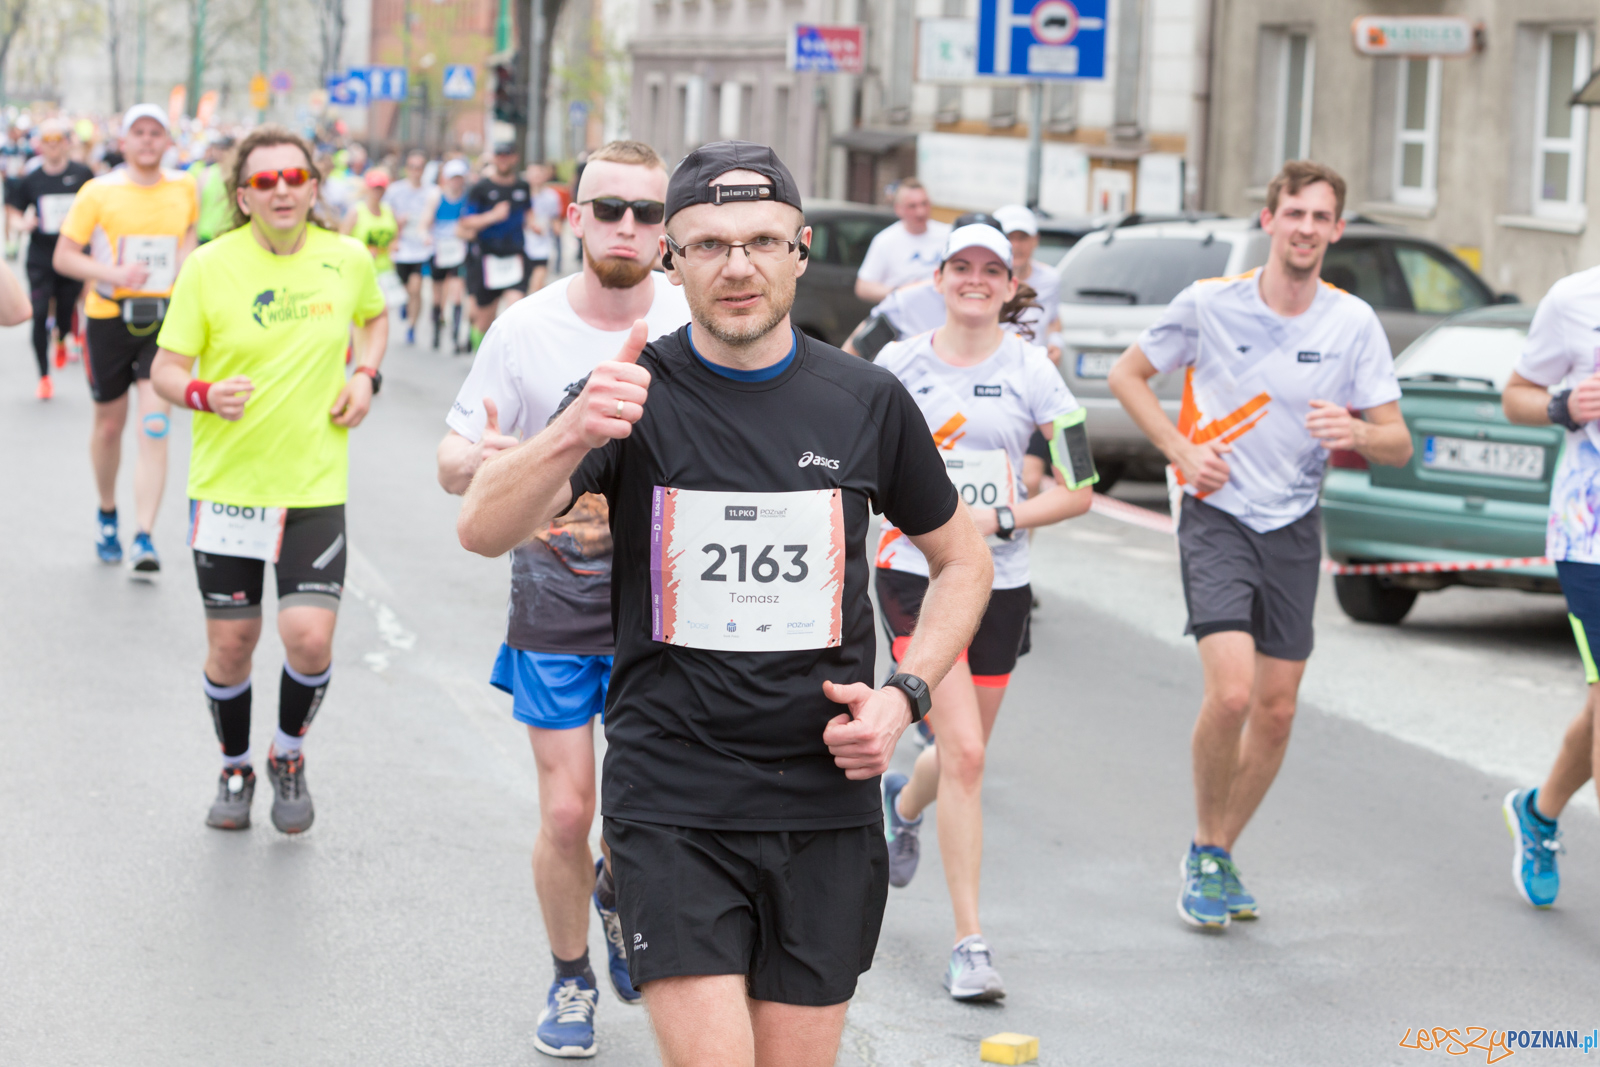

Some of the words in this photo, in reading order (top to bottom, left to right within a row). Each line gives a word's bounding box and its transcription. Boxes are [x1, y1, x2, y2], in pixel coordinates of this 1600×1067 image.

[721, 189, 757, 197] alenji
[267, 304, 308, 322] WORLD
[729, 509, 738, 517] 11.
[738, 509, 755, 517] PKO
[700, 543, 809, 584] 2163
[729, 592, 780, 604] Tomasz
